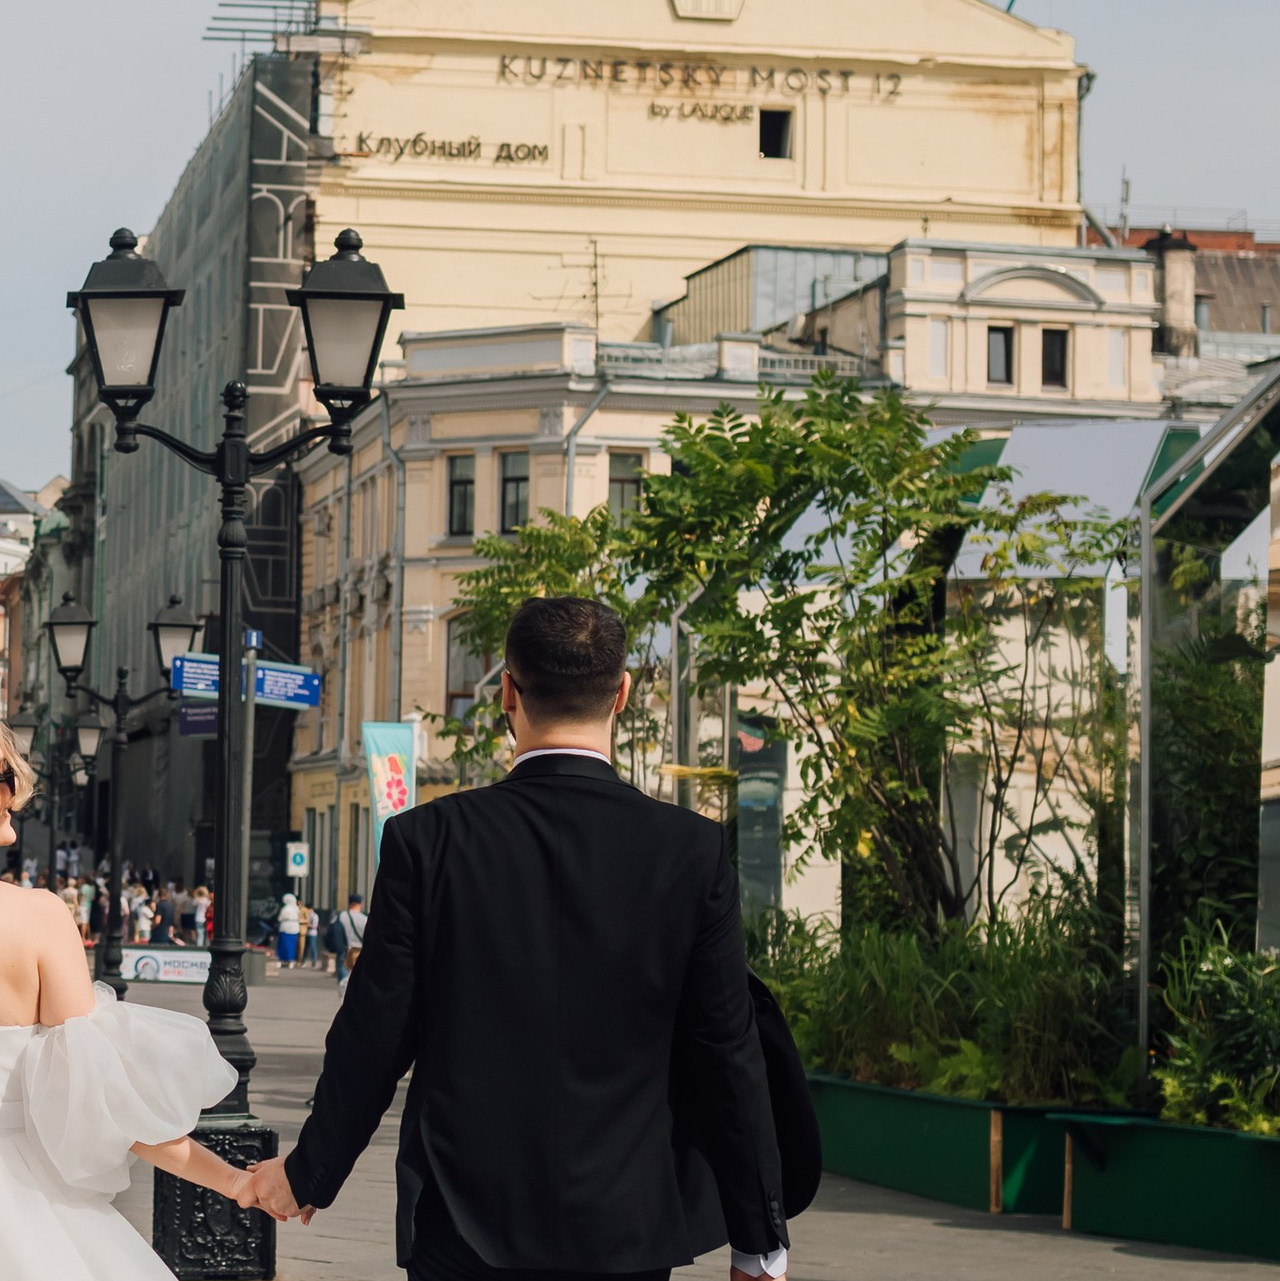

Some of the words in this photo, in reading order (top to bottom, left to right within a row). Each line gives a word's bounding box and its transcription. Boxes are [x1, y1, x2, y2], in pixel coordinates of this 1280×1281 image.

[499, 54, 727, 88] KUZNETSKY
[750, 65, 854, 94] MOST
[875, 72, 902, 96] 12
[357, 131, 482, 163] Клубный
[495, 142, 549, 163] дом
